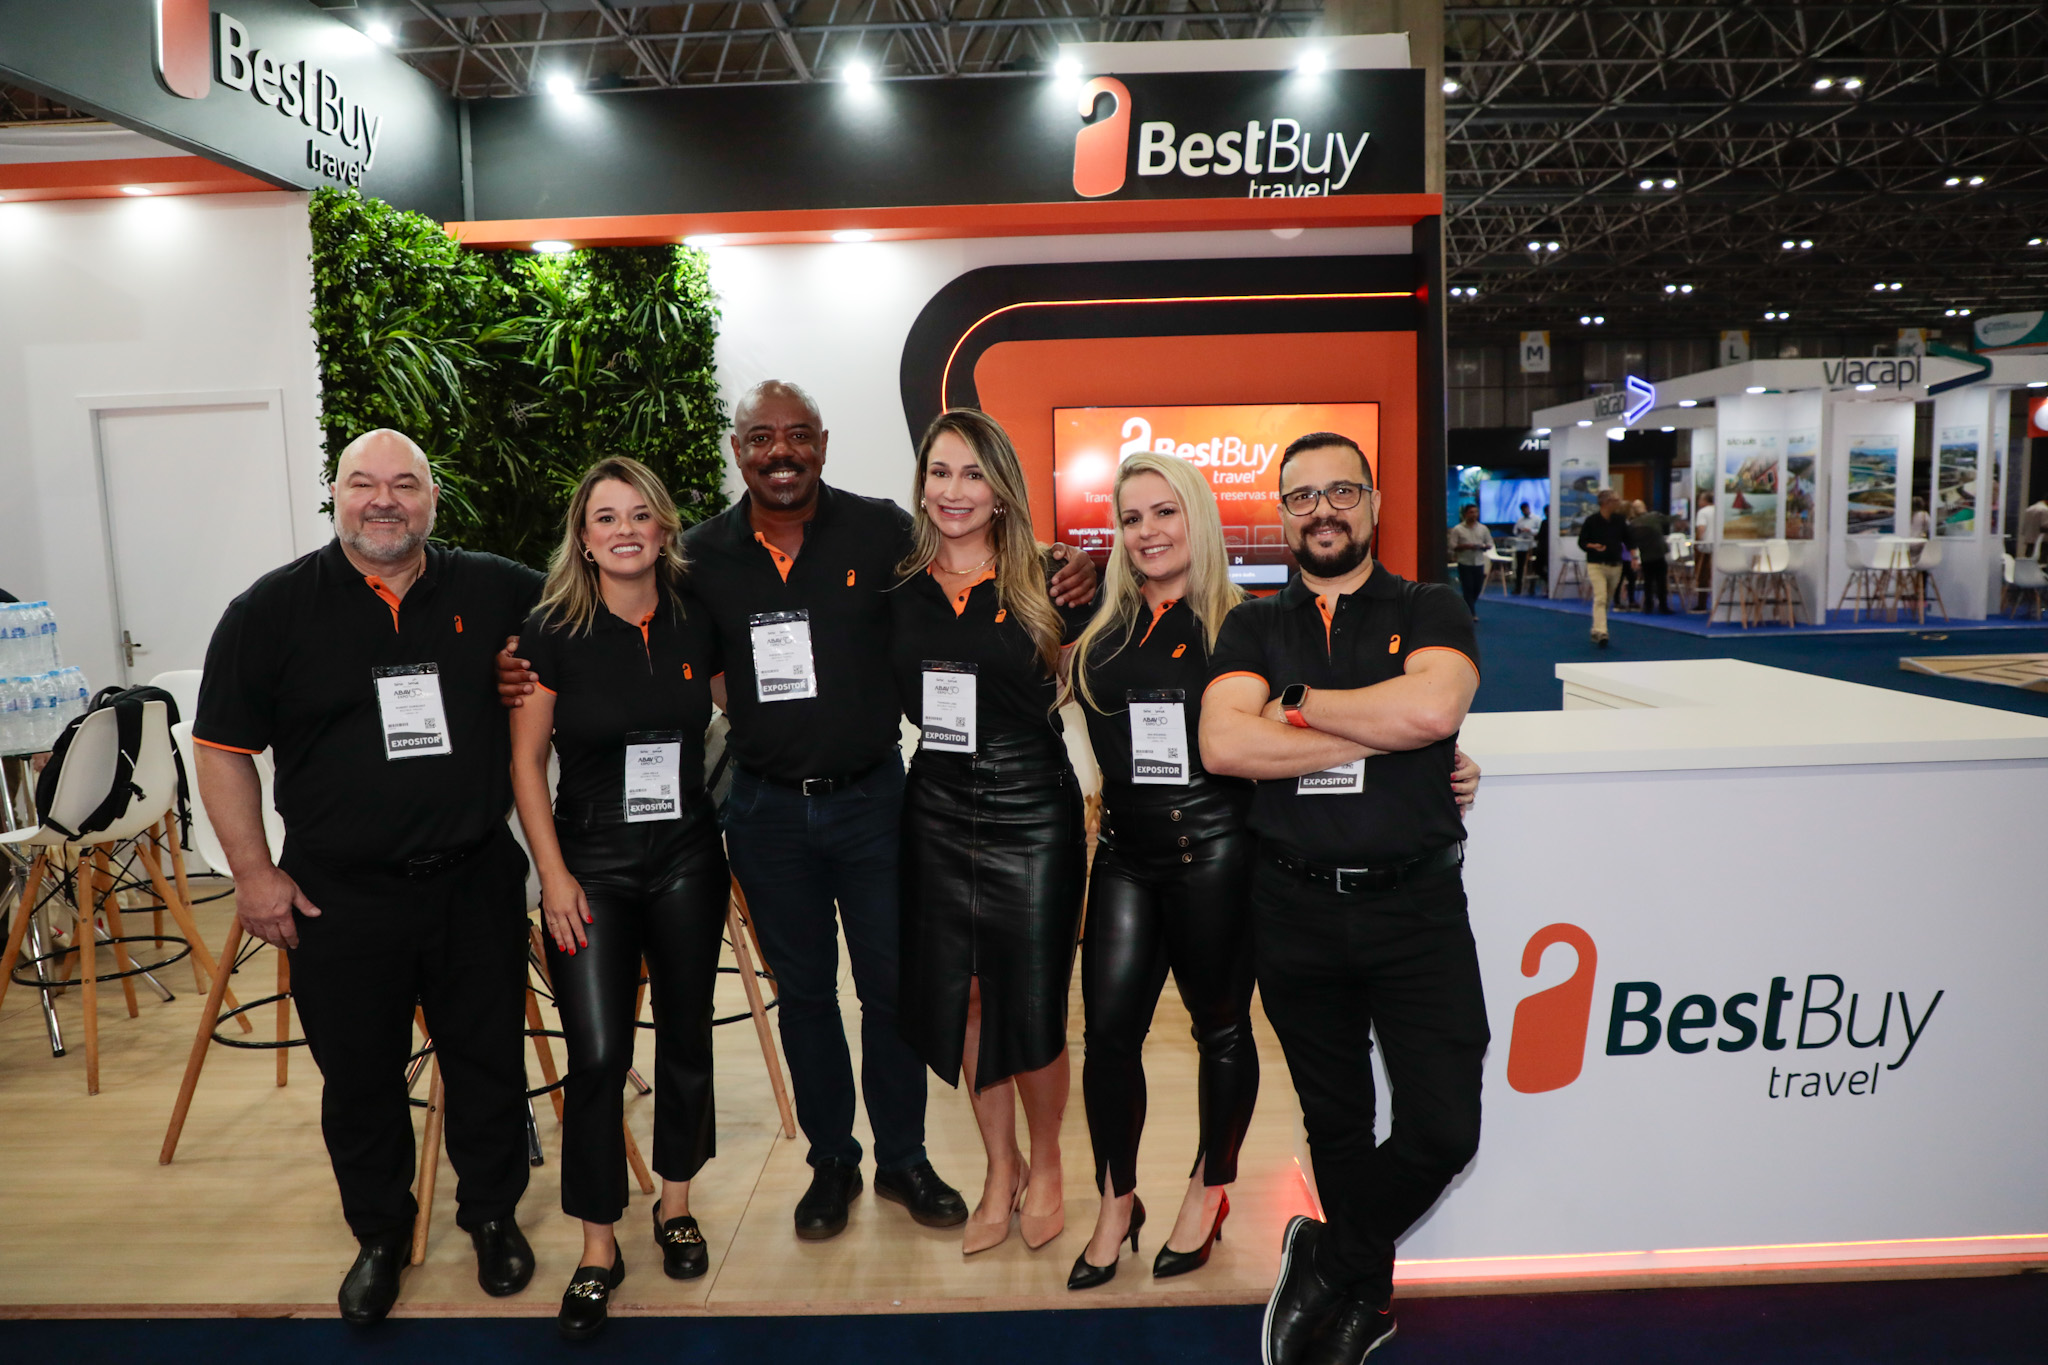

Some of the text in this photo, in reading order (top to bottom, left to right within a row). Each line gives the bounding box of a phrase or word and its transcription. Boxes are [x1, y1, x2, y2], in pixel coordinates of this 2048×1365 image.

[213, 12, 383, 171] BestBuy
[1137, 118, 1370, 191] BestBuy
[307, 139, 362, 188] travel
[1249, 178, 1330, 199] travel
[1527, 345, 1543, 360] M
[1729, 345, 1741, 360] L
[1823, 355, 1921, 391] viacapi
[1213, 470, 1256, 484] travel
[1220, 491, 1267, 501] reservas
[763, 682, 806, 693] EXPOSITOR
[391, 736, 440, 748] EXPOSITOR
[925, 731, 967, 742] EXPOSITOR
[1136, 766, 1180, 774] EXPOSITOR
[1303, 777, 1354, 786] EXPOSITOR
[630, 802, 673, 813] EXPOSITOR
[1606, 974, 1945, 1070] BestBuy
[1768, 1062, 1880, 1099] travel
